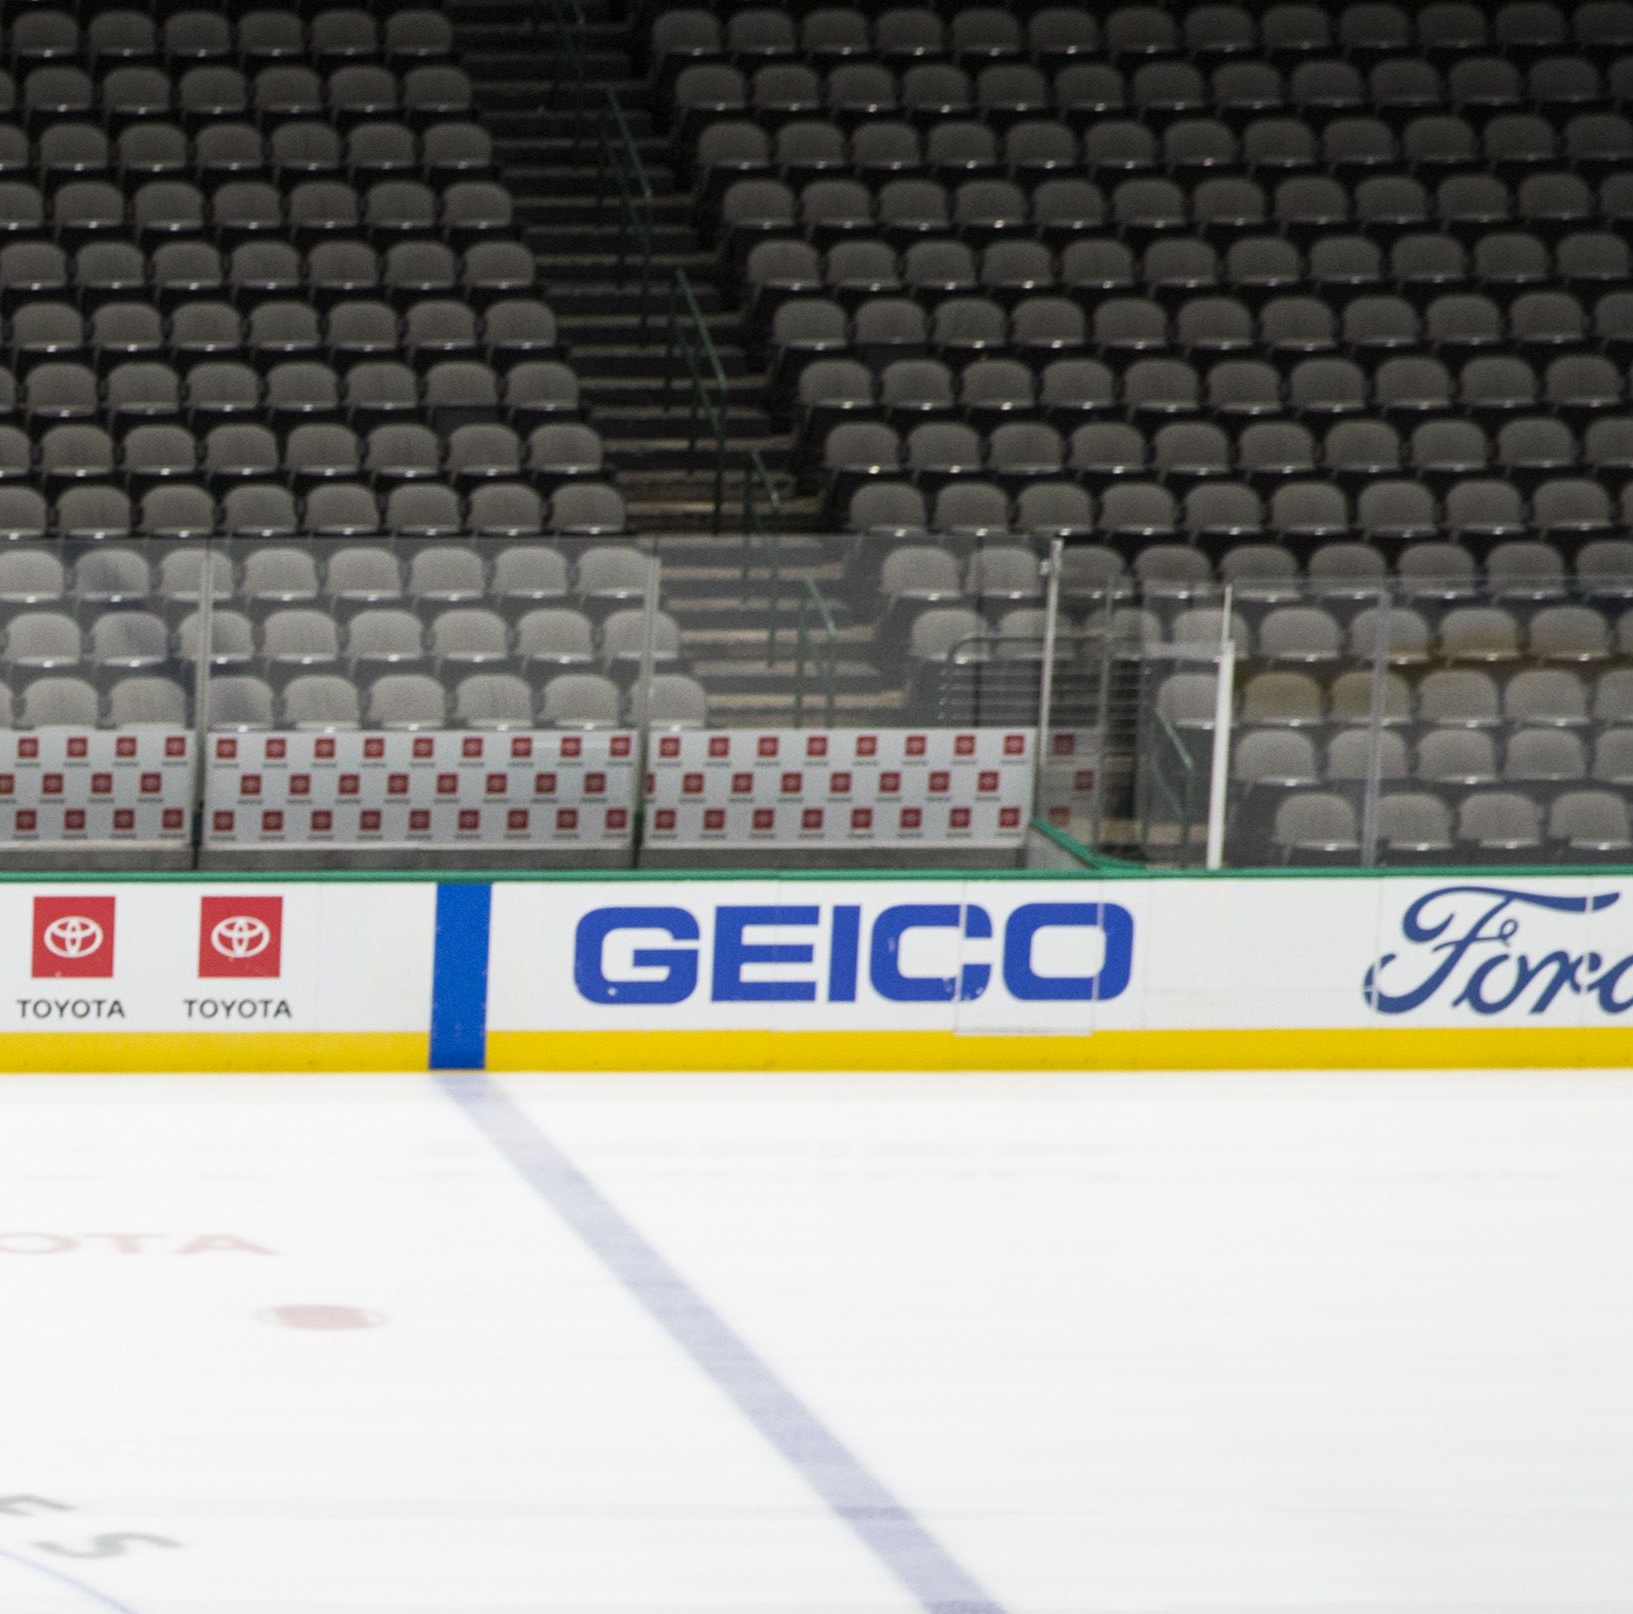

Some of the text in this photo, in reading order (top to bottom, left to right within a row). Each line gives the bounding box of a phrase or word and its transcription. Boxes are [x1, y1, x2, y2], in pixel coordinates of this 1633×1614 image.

[573, 903, 1134, 1004] GEICO
[17, 999, 125, 1020] TOYOTA
[185, 999, 292, 1020] TOYOTA
